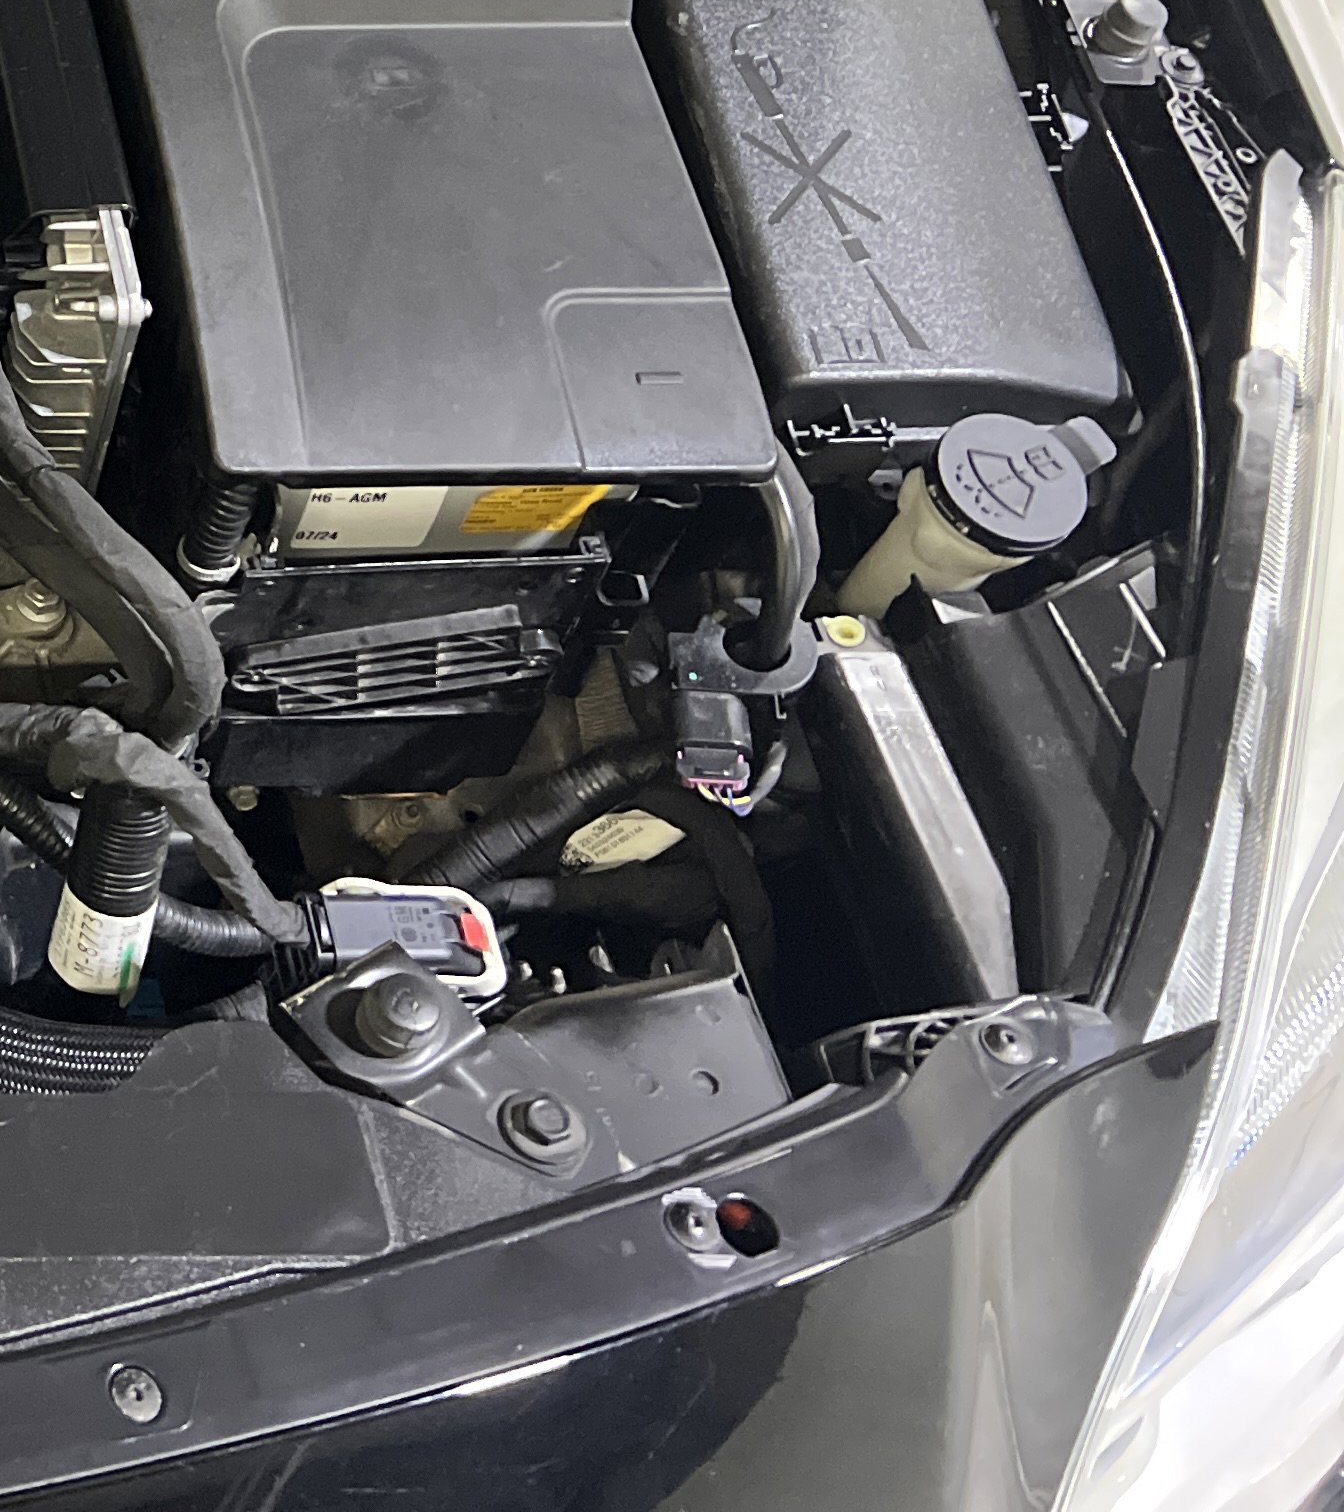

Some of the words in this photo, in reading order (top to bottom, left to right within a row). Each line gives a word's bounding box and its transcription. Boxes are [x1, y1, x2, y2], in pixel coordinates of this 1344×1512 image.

[311, 492, 333, 503] H6
[349, 492, 387, 503] AGM
[73, 912, 104, 979] M-8773
